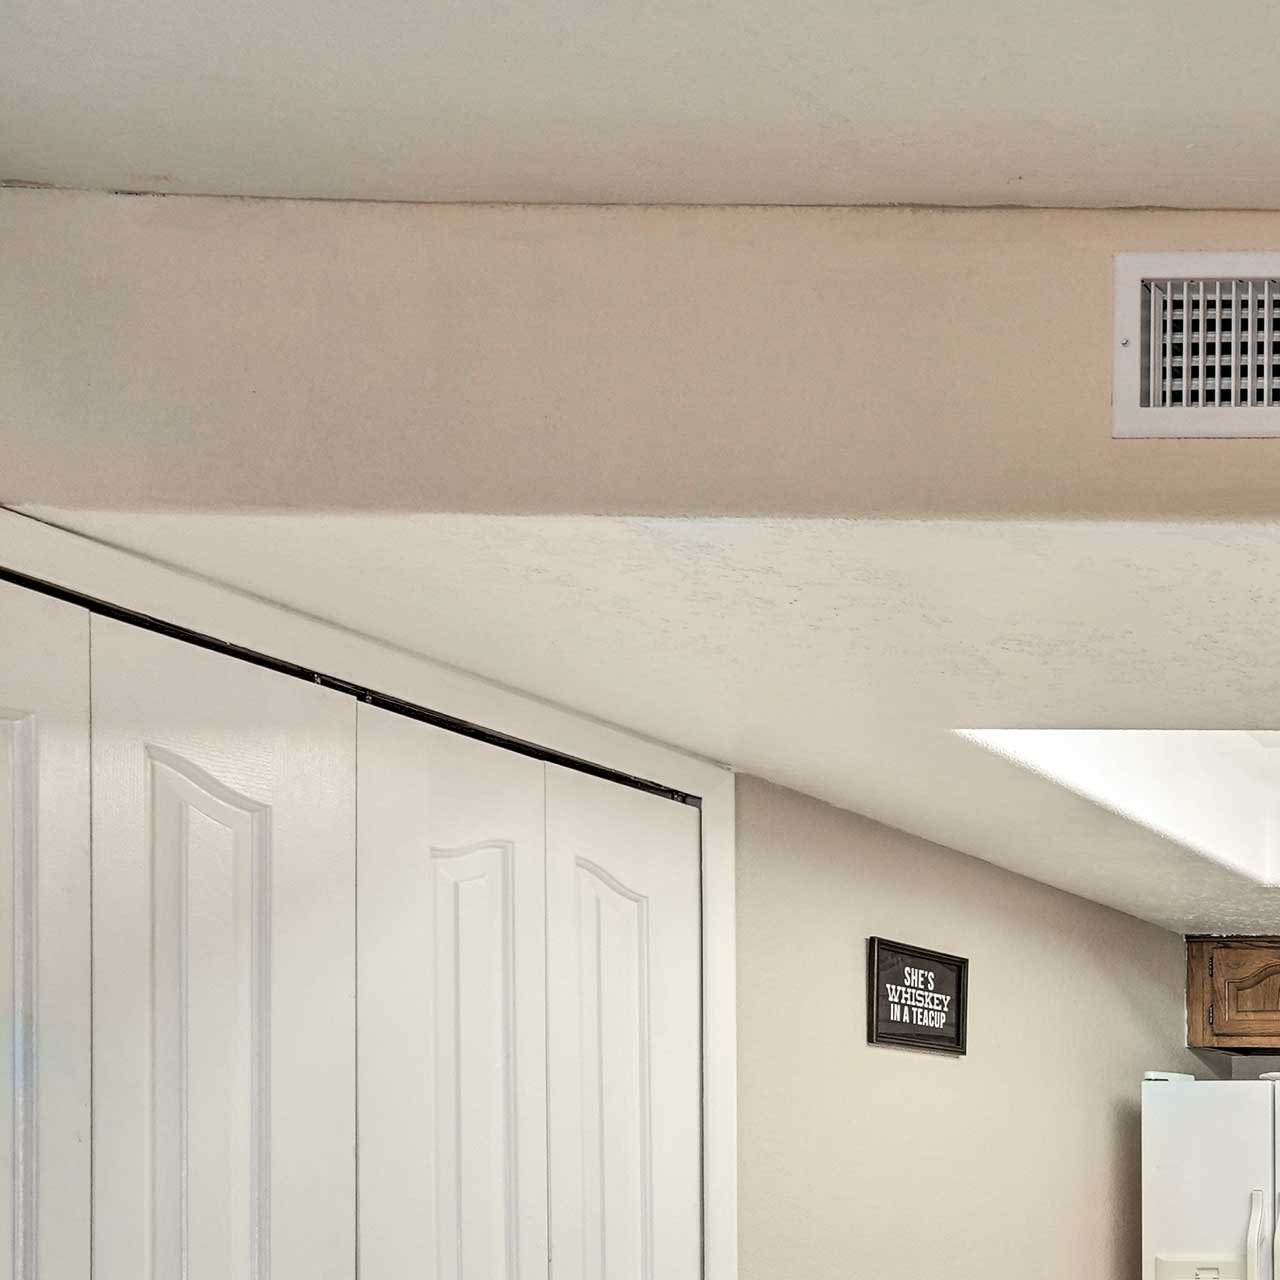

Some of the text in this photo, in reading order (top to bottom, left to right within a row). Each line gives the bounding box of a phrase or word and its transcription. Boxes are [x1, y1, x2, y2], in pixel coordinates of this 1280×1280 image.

[904, 966, 935, 991] SHE'S
[885, 983, 951, 1012] WHISKEY
[890, 1003, 946, 1029] IN A TEACUP
